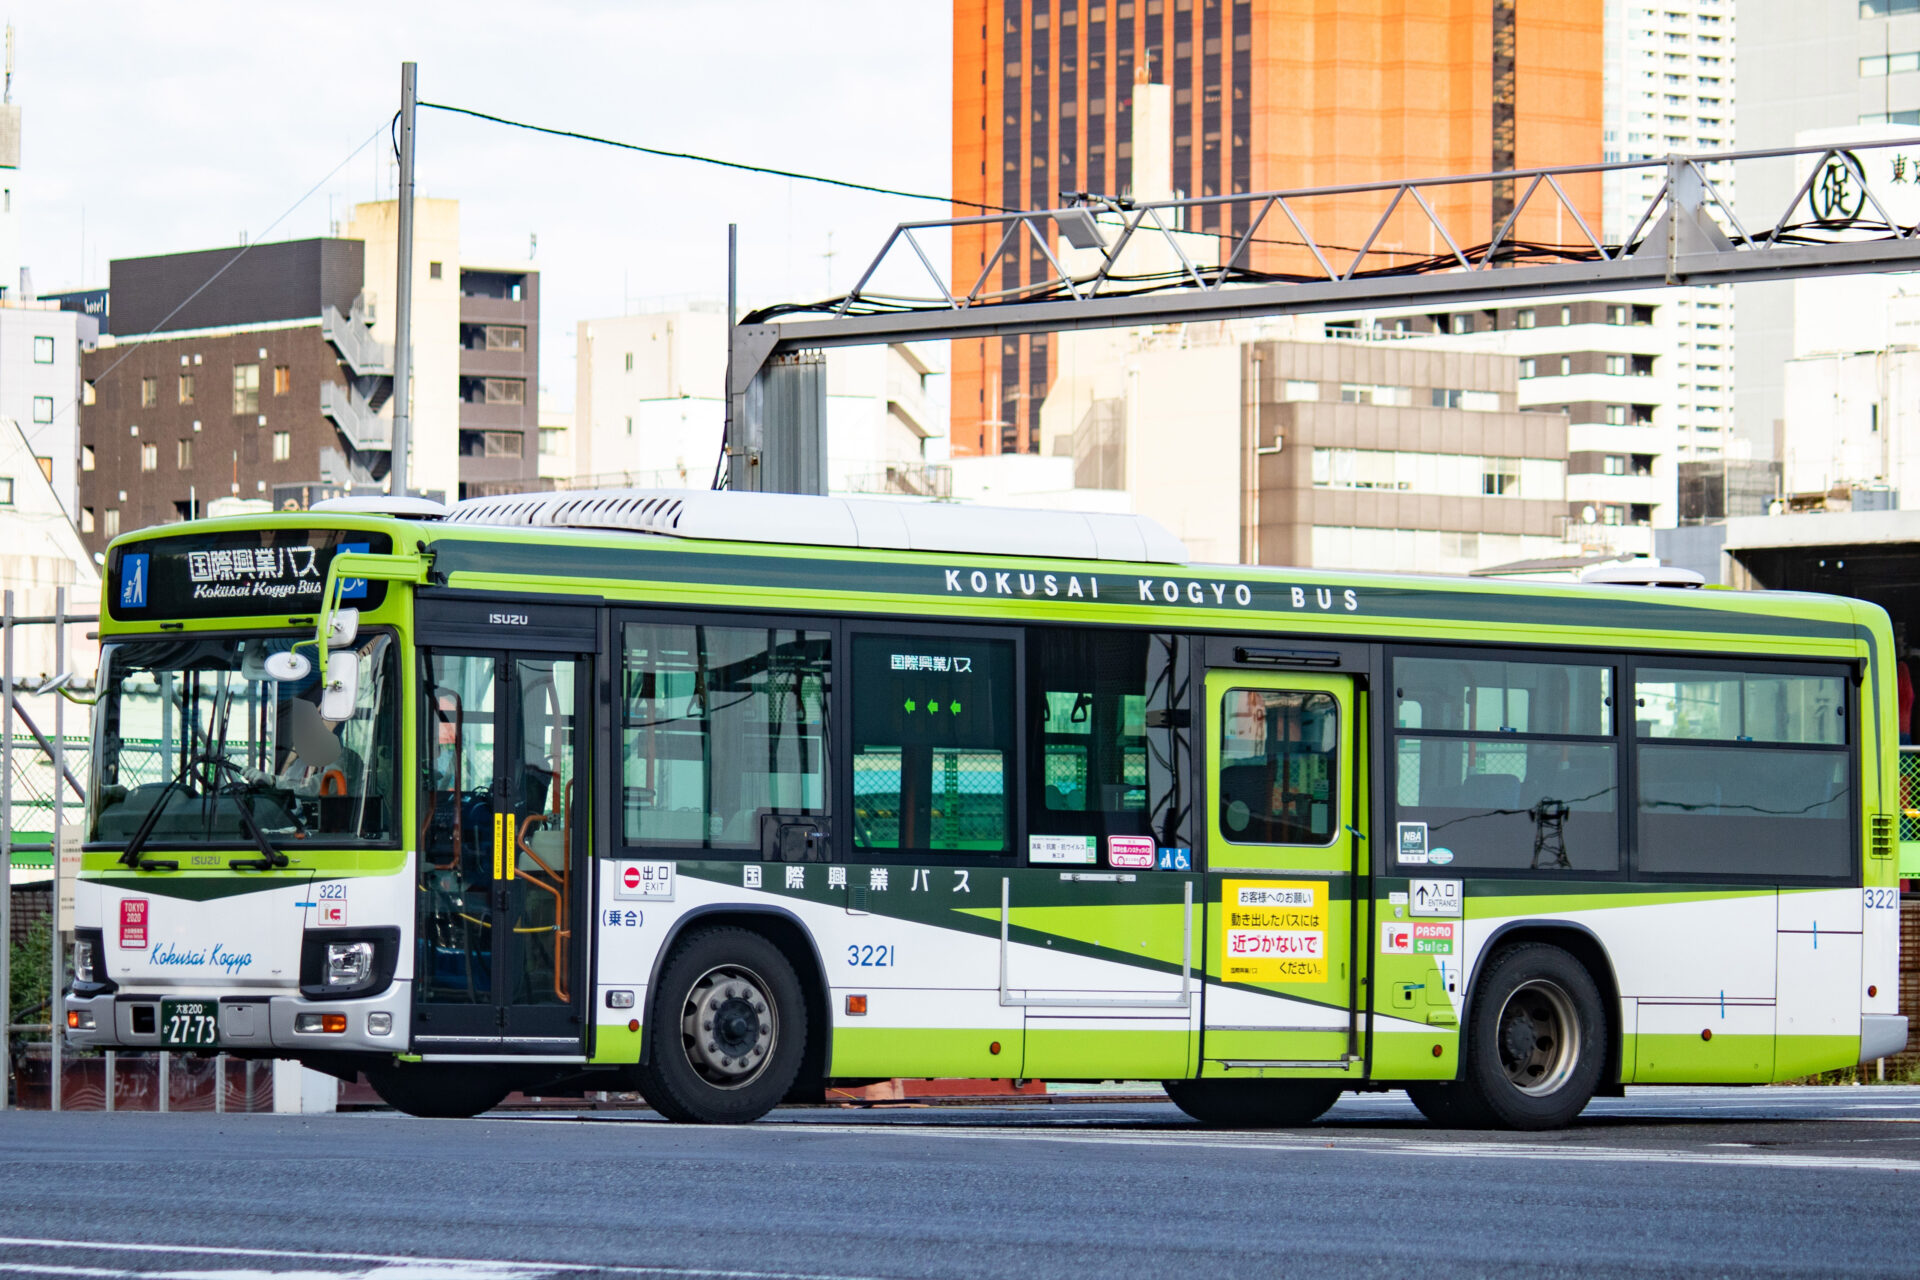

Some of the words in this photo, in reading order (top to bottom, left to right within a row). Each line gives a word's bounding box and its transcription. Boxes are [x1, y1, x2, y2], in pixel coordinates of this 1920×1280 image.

[188, 546, 320, 582] 国際興業バス
[194, 581, 250, 599] Kokusai
[252, 581, 296, 598] Kogyo
[297, 580, 321, 595] Bus
[945, 570, 1098, 598] KOKUSAI
[1138, 579, 1251, 606] KOGYO
[1290, 587, 1358, 611] BUS
[489, 613, 528, 626] ISUZU
[890, 654, 972, 673] 国際興業バス
[1404, 831, 1421, 842] NBA
[191, 856, 221, 866] ISUZU
[643, 865, 669, 881] 出口
[743, 864, 970, 893] 国際興業バス
[319, 884, 347, 899] 3221
[645, 882, 665, 892] EXIT
[1431, 883, 1454, 897] 入口
[1240, 891, 1312, 904] お客様へのお願い
[1428, 899, 1457, 908] ENTRANCE
[1865, 889, 1898, 909] 3221
[124, 902, 144, 913] TOKYO
[127, 913, 141, 922] 2020
[602, 909, 644, 927] (乗合)
[1231, 913, 1320, 927] 動き出したバスには
[1416, 926, 1451, 937] PASMO
[1232, 934, 1317, 954] 近づかないで
[1417, 940, 1449, 952] Suica
[149, 943, 206, 967] Kokusai
[209, 943, 252, 975] Kogyo
[847, 945, 894, 967] 3221
[1279, 962, 1322, 975] ください。
